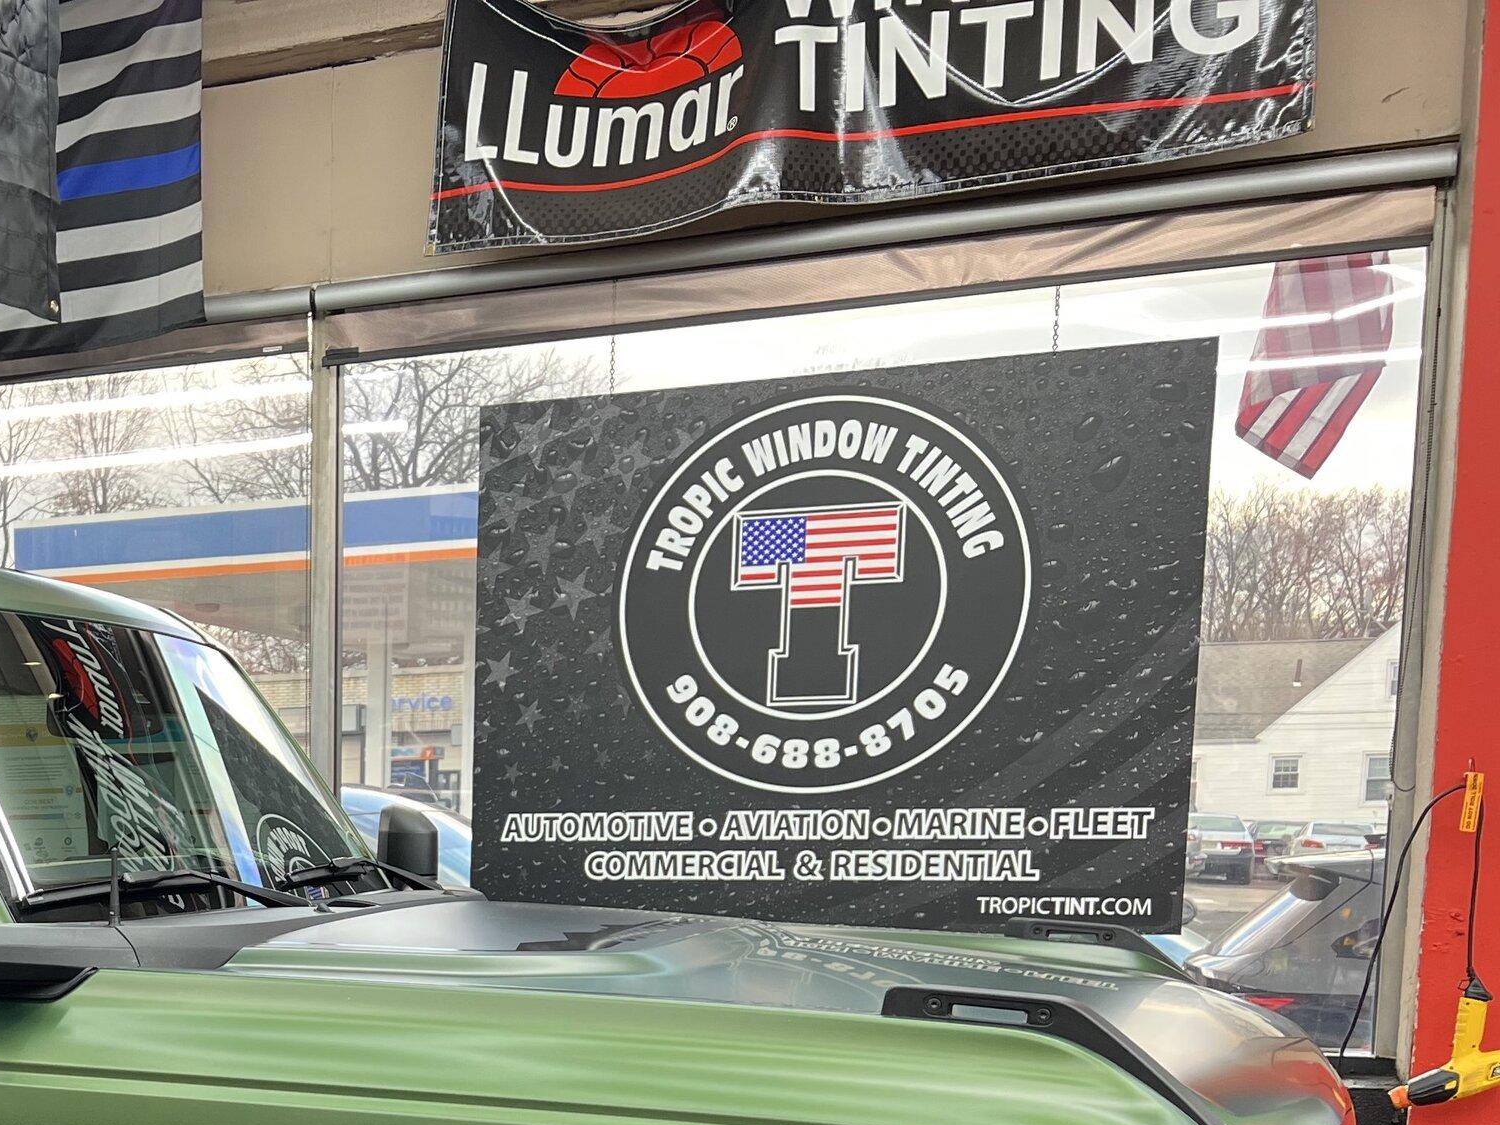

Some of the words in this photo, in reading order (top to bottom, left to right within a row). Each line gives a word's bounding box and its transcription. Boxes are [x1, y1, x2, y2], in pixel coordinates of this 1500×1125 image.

[775, 0, 1259, 112] TINTING
[647, 457, 746, 573] TROPIC
[741, 419, 896, 480] WINDOW
[903, 435, 1005, 561] TINTING
[665, 663, 971, 768] 908-688-8705
[501, 811, 693, 843] AUTOMOTIVE
[720, 810, 870, 840] AVIATION
[892, 809, 1025, 840] MARINE
[1049, 808, 1155, 840] FLEET
[584, 851, 786, 881] COMMERCIAL
[794, 853, 824, 881] &
[830, 850, 1040, 880] RESIDENTIAL
[976, 895, 1153, 918] TROPICTINT.COM
